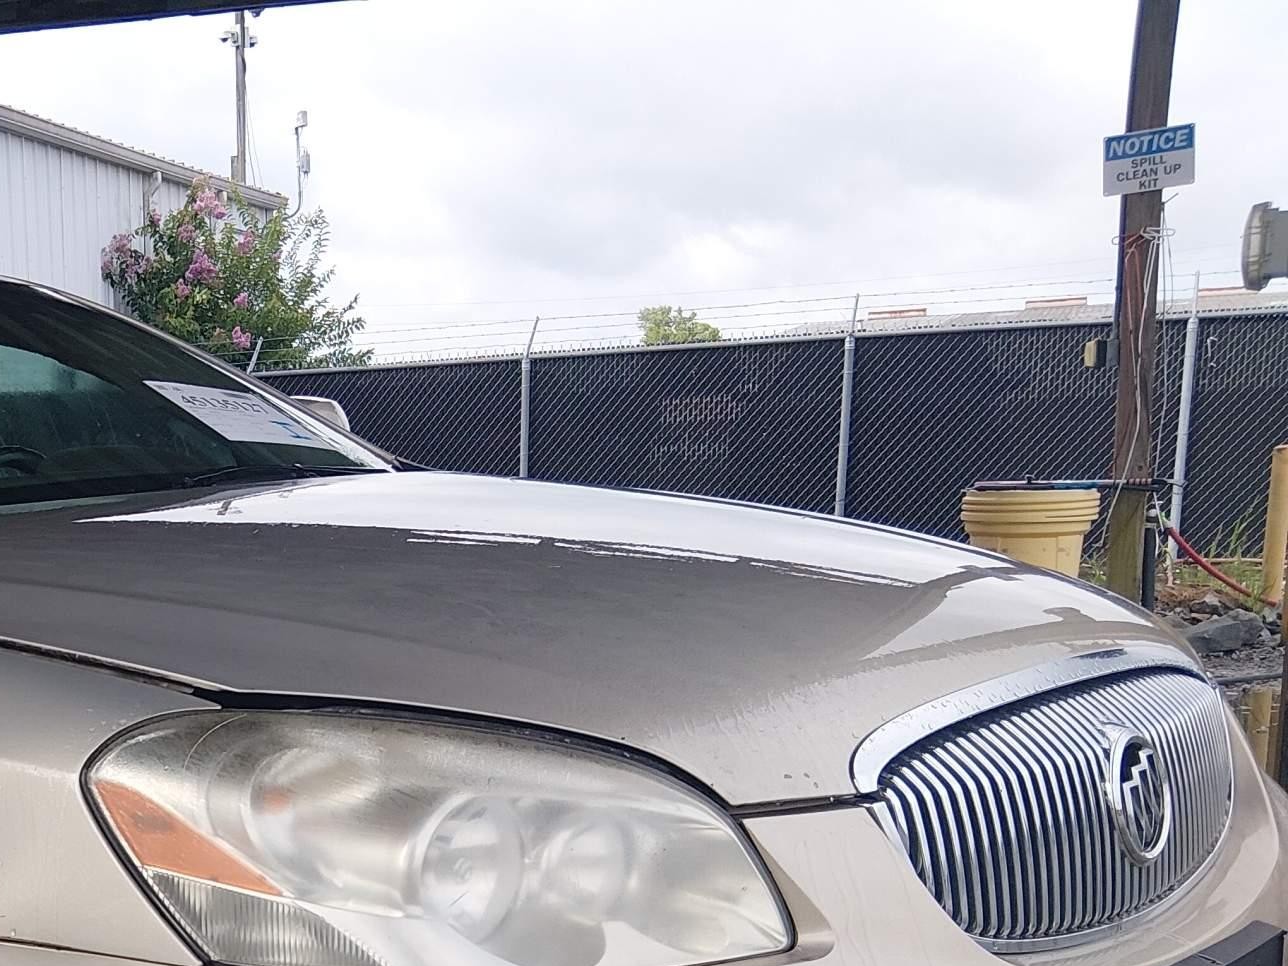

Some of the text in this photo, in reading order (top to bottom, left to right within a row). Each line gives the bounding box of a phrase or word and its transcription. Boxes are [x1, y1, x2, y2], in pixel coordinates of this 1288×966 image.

[1108, 129, 1190, 158] NOTICE
[1131, 155, 1167, 168] SPILL
[1116, 163, 1182, 182] CLEAN UP
[1138, 178, 1159, 190] KIT
